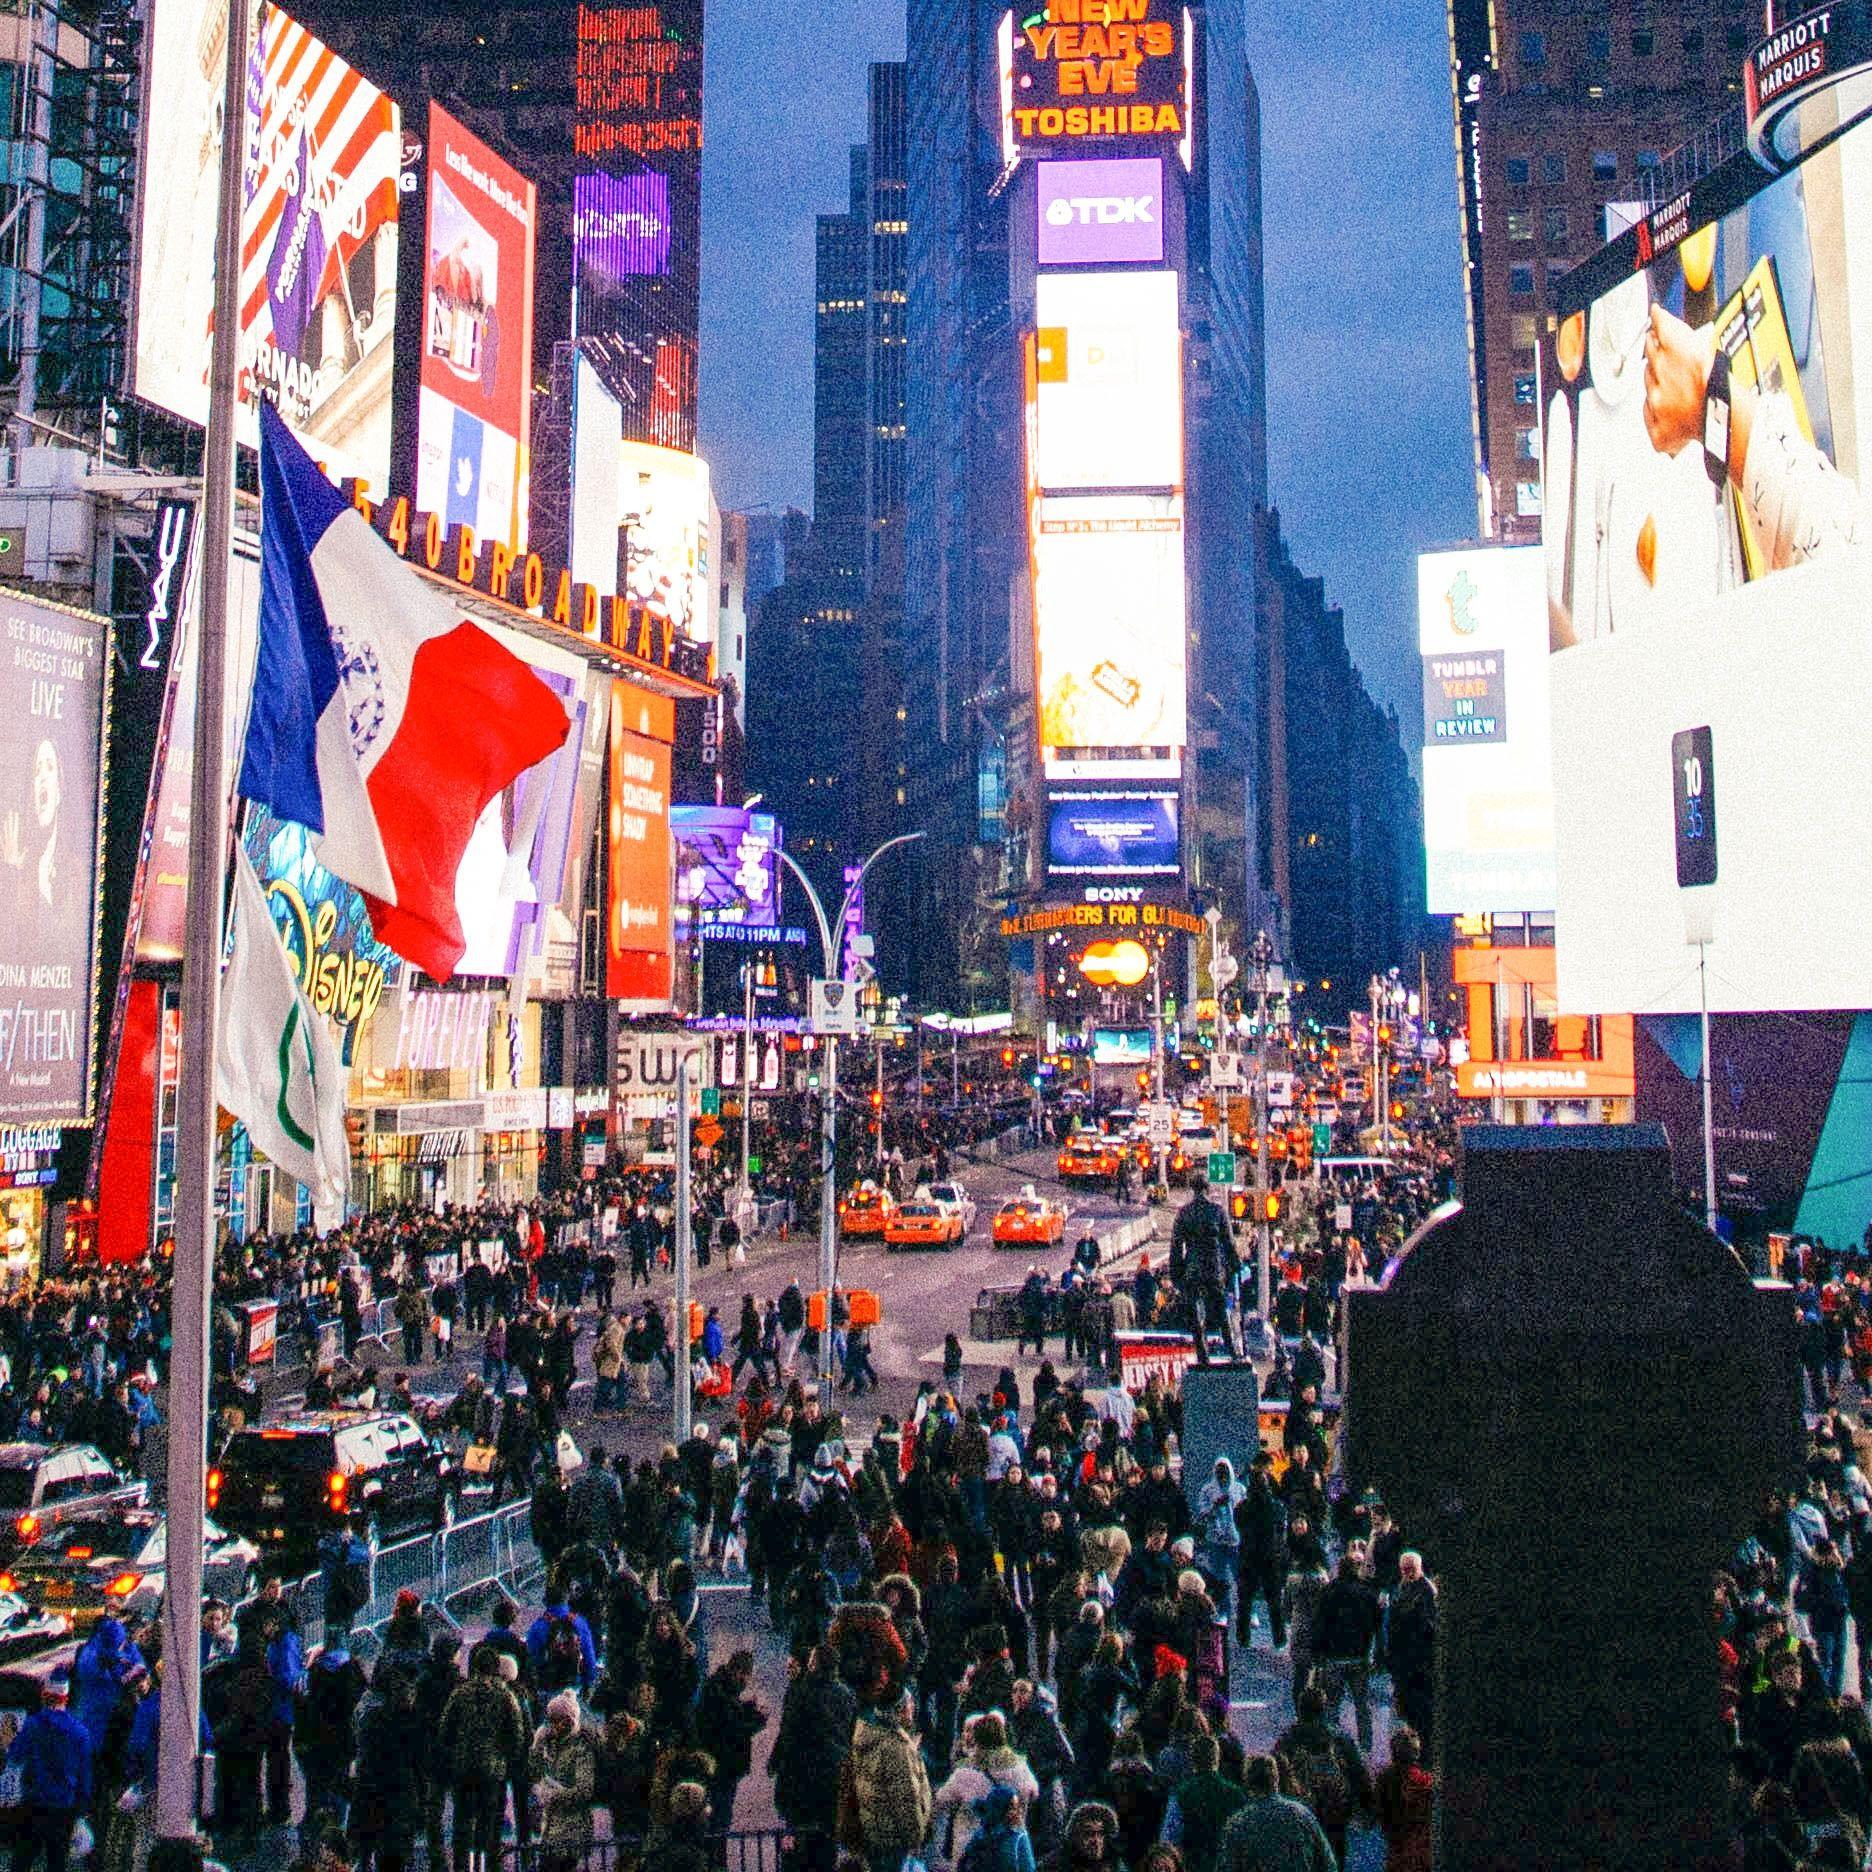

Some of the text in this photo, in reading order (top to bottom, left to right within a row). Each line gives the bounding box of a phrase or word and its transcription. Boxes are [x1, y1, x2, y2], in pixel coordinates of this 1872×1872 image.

[1025, 22, 1172, 60] YEAR'S
[1757, 13, 1831, 66] MARRIOTT
[1057, 59, 1138, 97] EVE
[1759, 46, 1822, 100] MARQUIS
[1014, 104, 1181, 138] TOSHIBA
[1071, 195, 1154, 224] TDK
[1652, 191, 1692, 236] MARRIOTT
[1653, 214, 1690, 254] MARQUIS
[457, 524, 676, 670] BROADWAY
[7, 616, 95, 658] SEE BROADWAY'S
[14, 645, 86, 683] BIGGEST STAR
[1432, 658, 1498, 677] TUMBLR
[30, 679, 66, 721] LIVE
[1443, 677, 1489, 699] YEAR
[1455, 699, 1476, 717] IN
[1435, 716, 1497, 739] REVIEW
[1684, 757, 1703, 797] 10
[1084, 887, 1145, 902] SONY
[1108, 905, 1138, 926] FOR
[29, 962, 74, 990] MENZEL
[395, 992, 491, 1070] FOREVER
[0, 1126, 63, 1152] LUGGAGE
[15, 1170, 40, 1186] SONY
